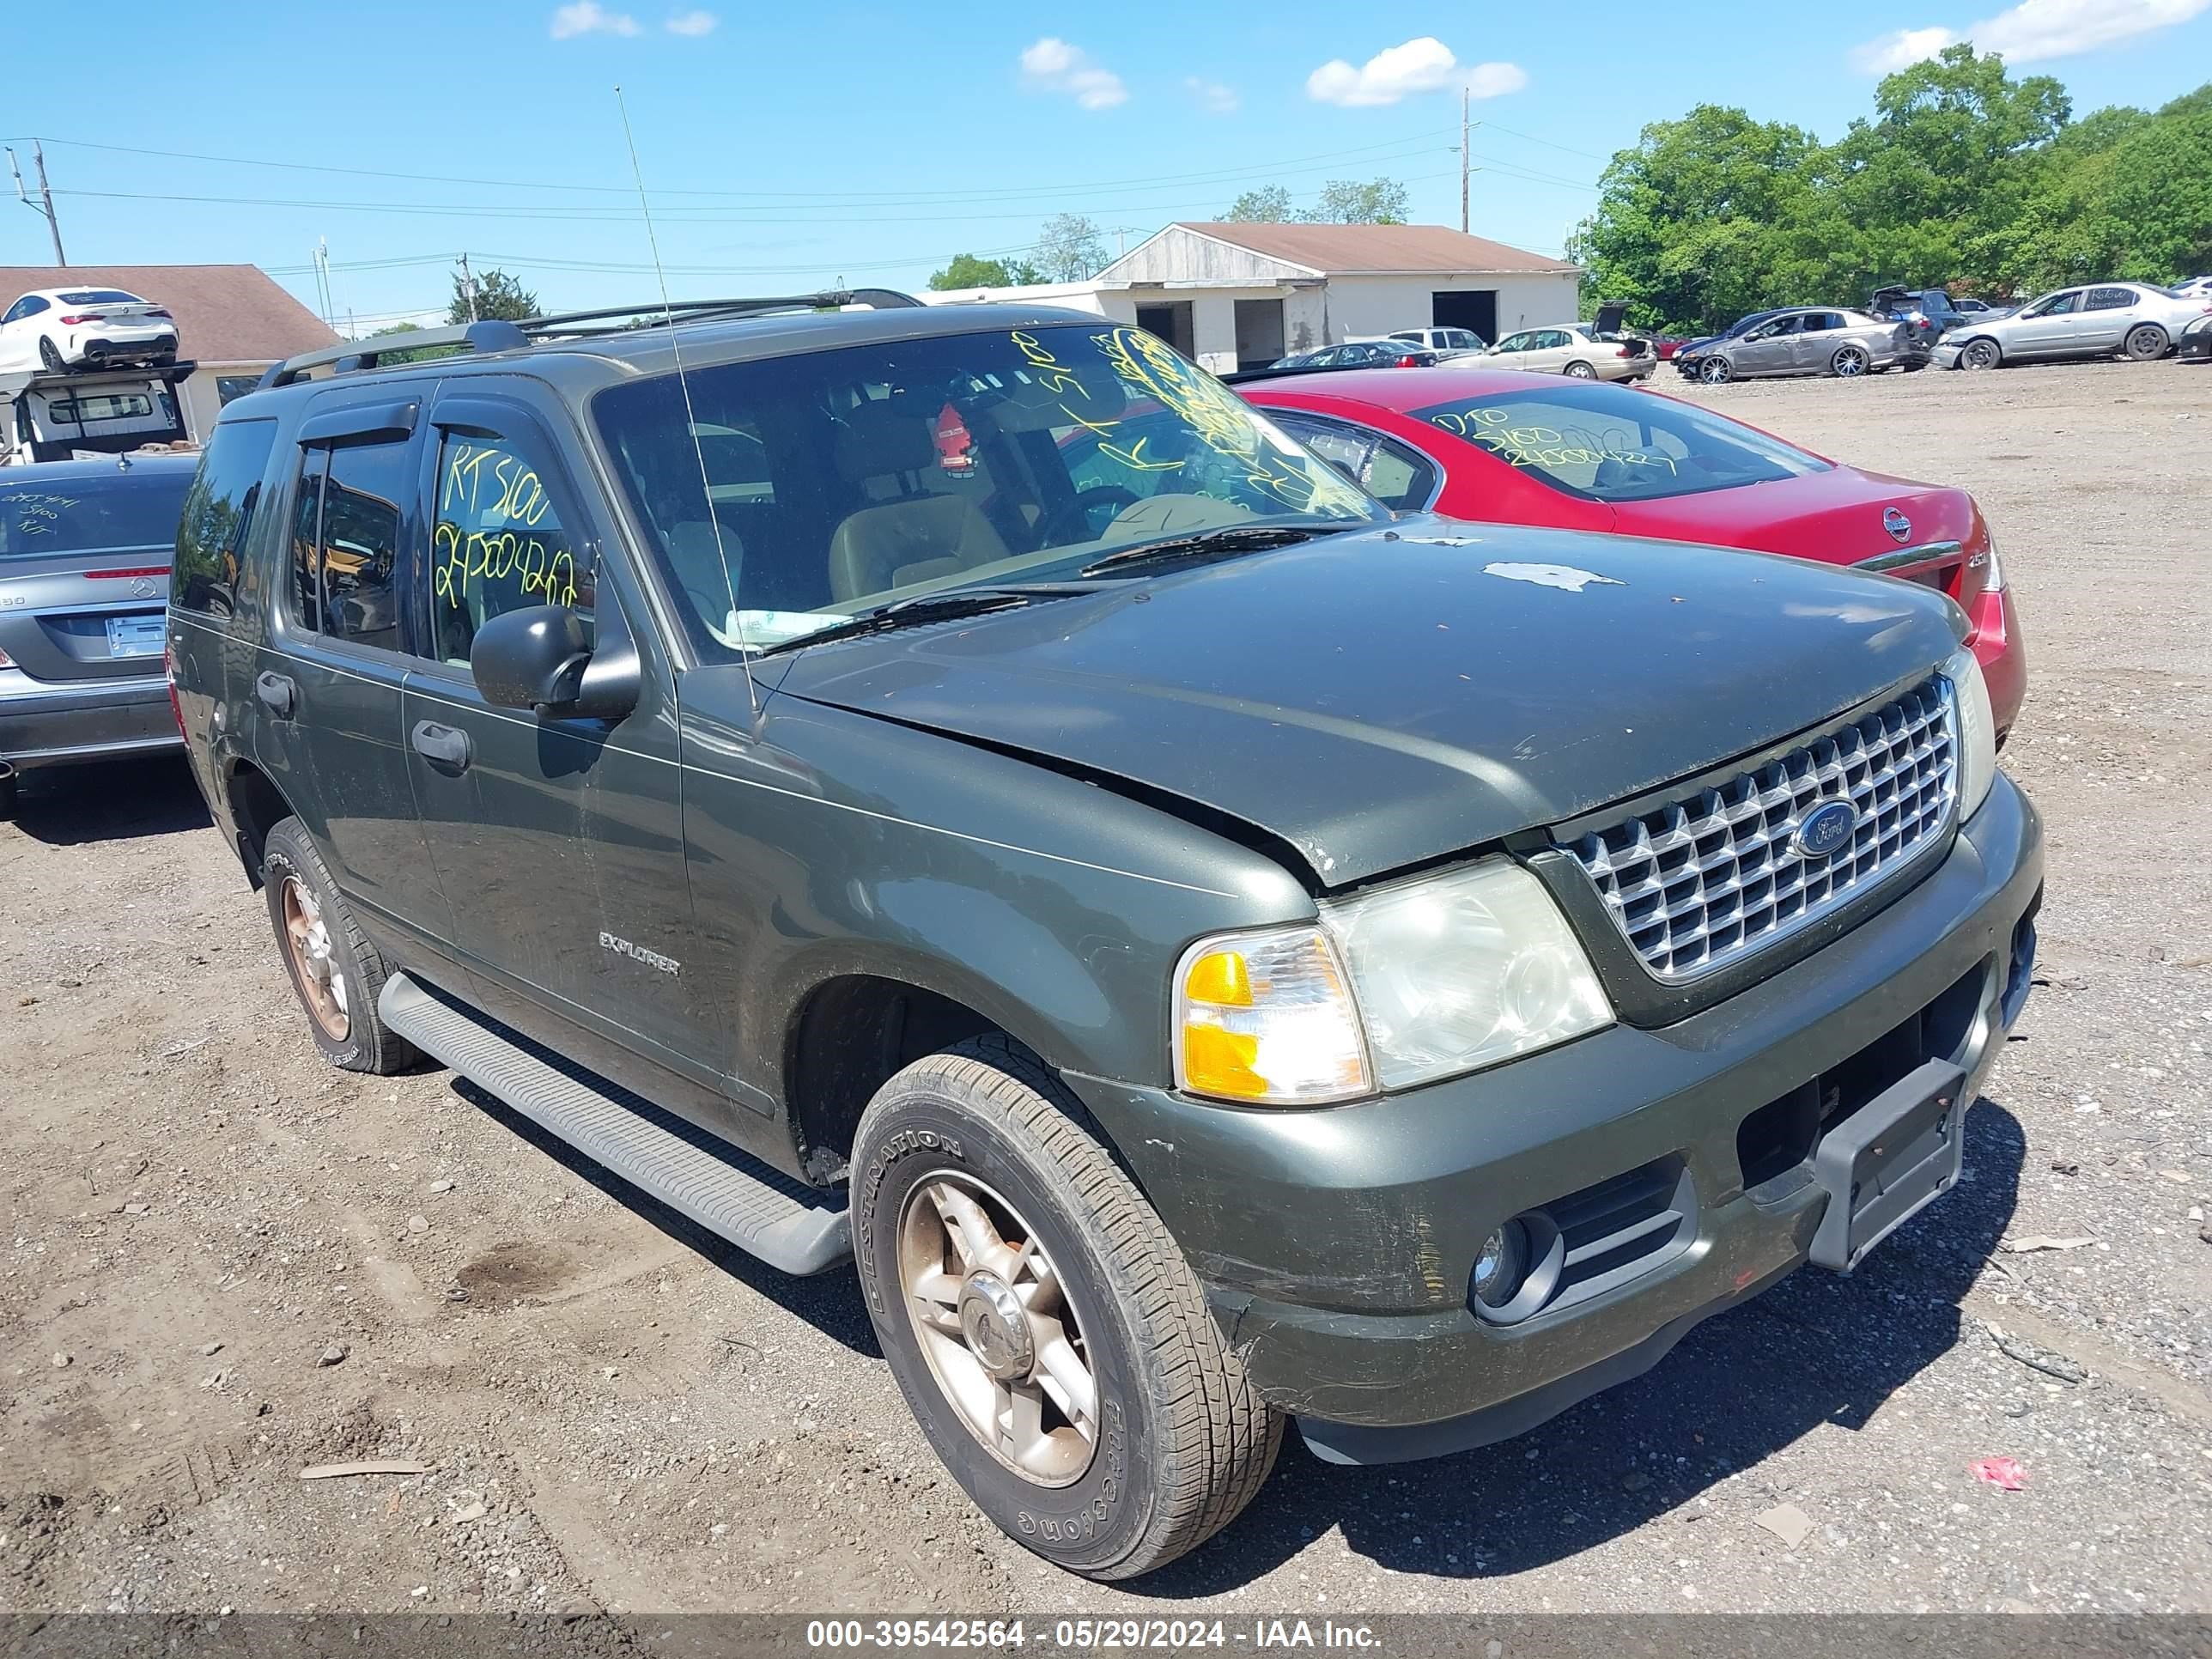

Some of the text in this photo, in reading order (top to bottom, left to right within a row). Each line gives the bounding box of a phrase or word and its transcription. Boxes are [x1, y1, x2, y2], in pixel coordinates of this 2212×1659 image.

[20, 504, 58, 520] S100
[1815, 813, 1845, 845] Ford
[599, 931, 681, 976] EXPLORER
[861, 1126, 963, 1315] DESTINATION
